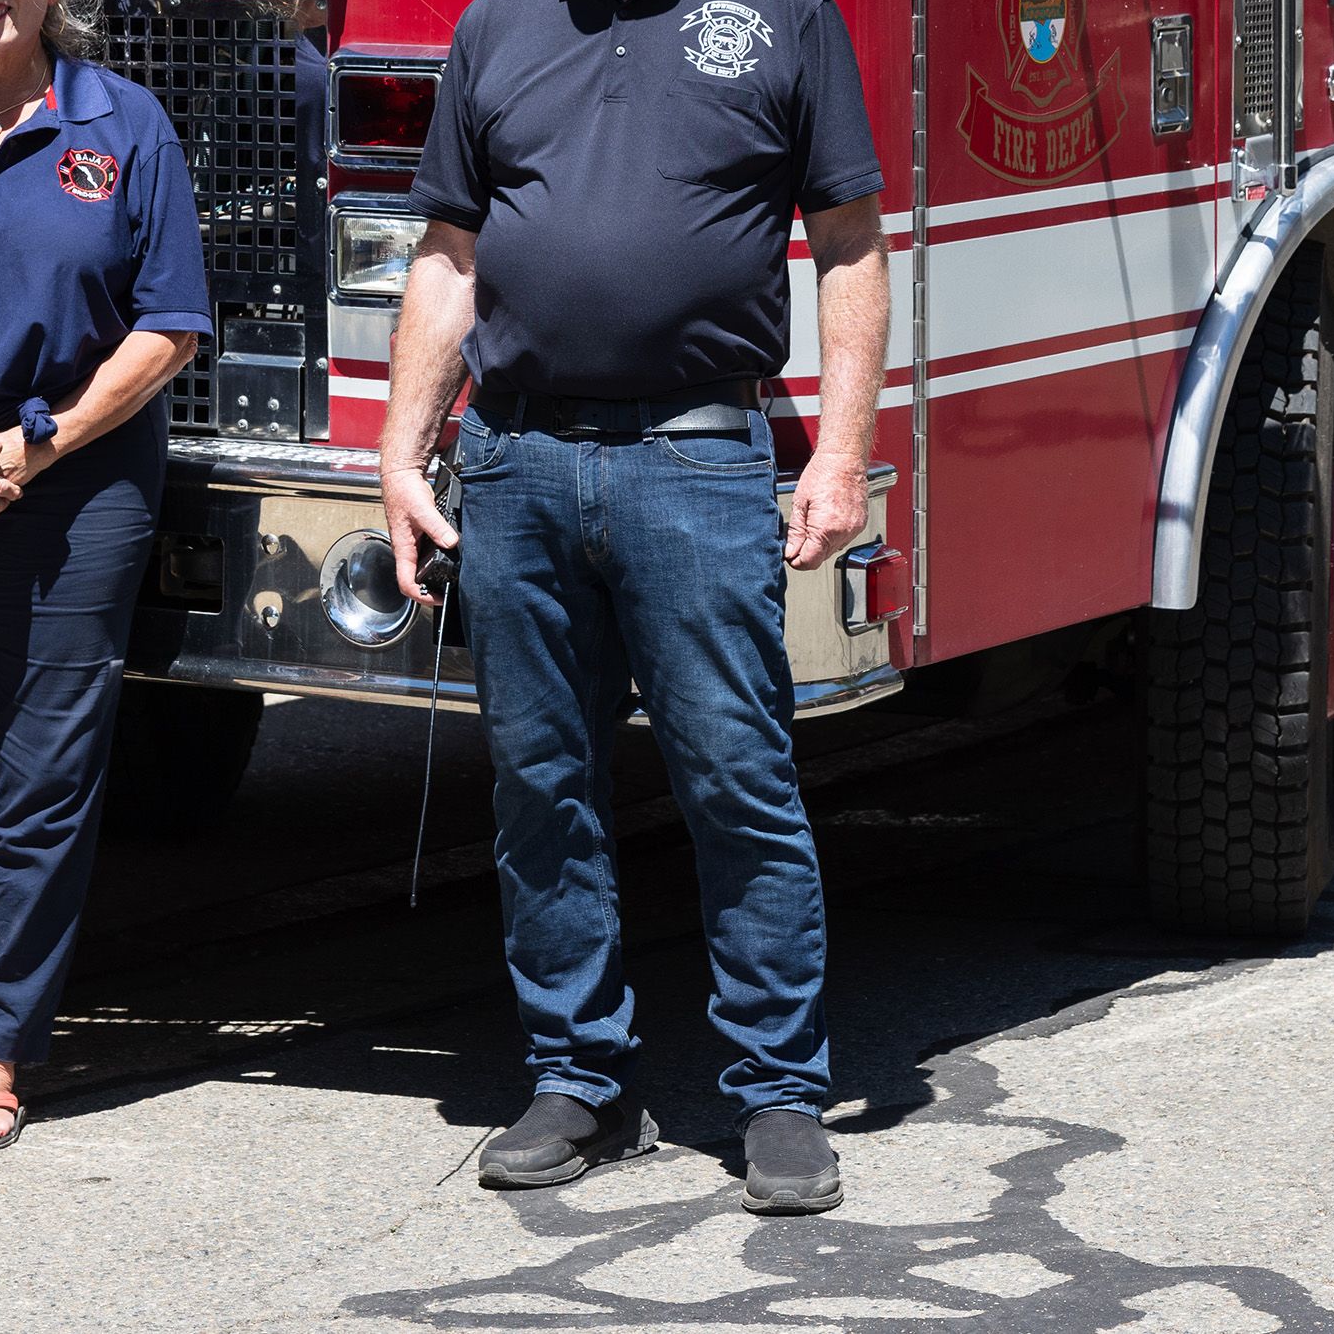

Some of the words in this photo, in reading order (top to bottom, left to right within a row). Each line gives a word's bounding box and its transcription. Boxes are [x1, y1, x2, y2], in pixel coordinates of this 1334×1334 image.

[75, 153, 101, 165] BAJA
[993, 112, 1036, 174] FIRE
[1046, 107, 1096, 172] DEPT.
